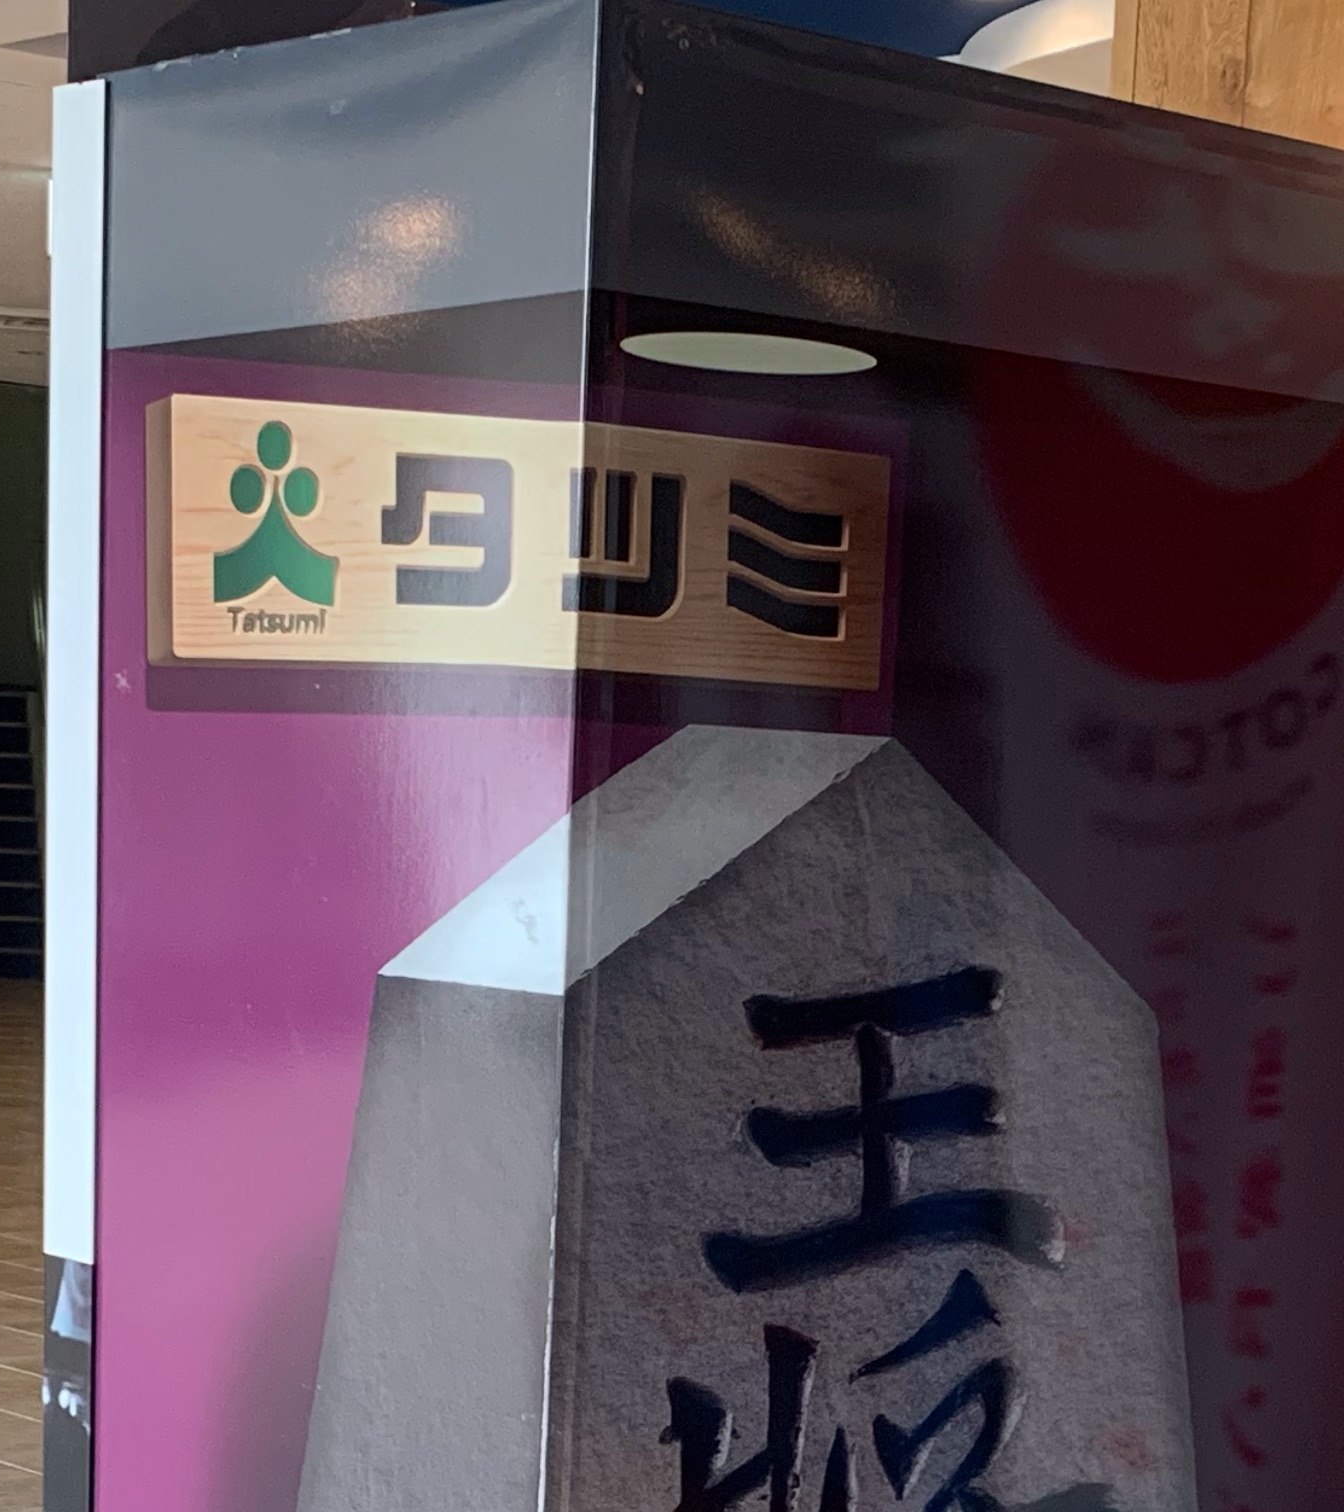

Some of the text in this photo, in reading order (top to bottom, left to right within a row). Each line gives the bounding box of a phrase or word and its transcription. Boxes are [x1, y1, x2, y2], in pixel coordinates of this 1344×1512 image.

[381, 451, 849, 641] タツミ
[227, 606, 327, 634] Tatsumi
